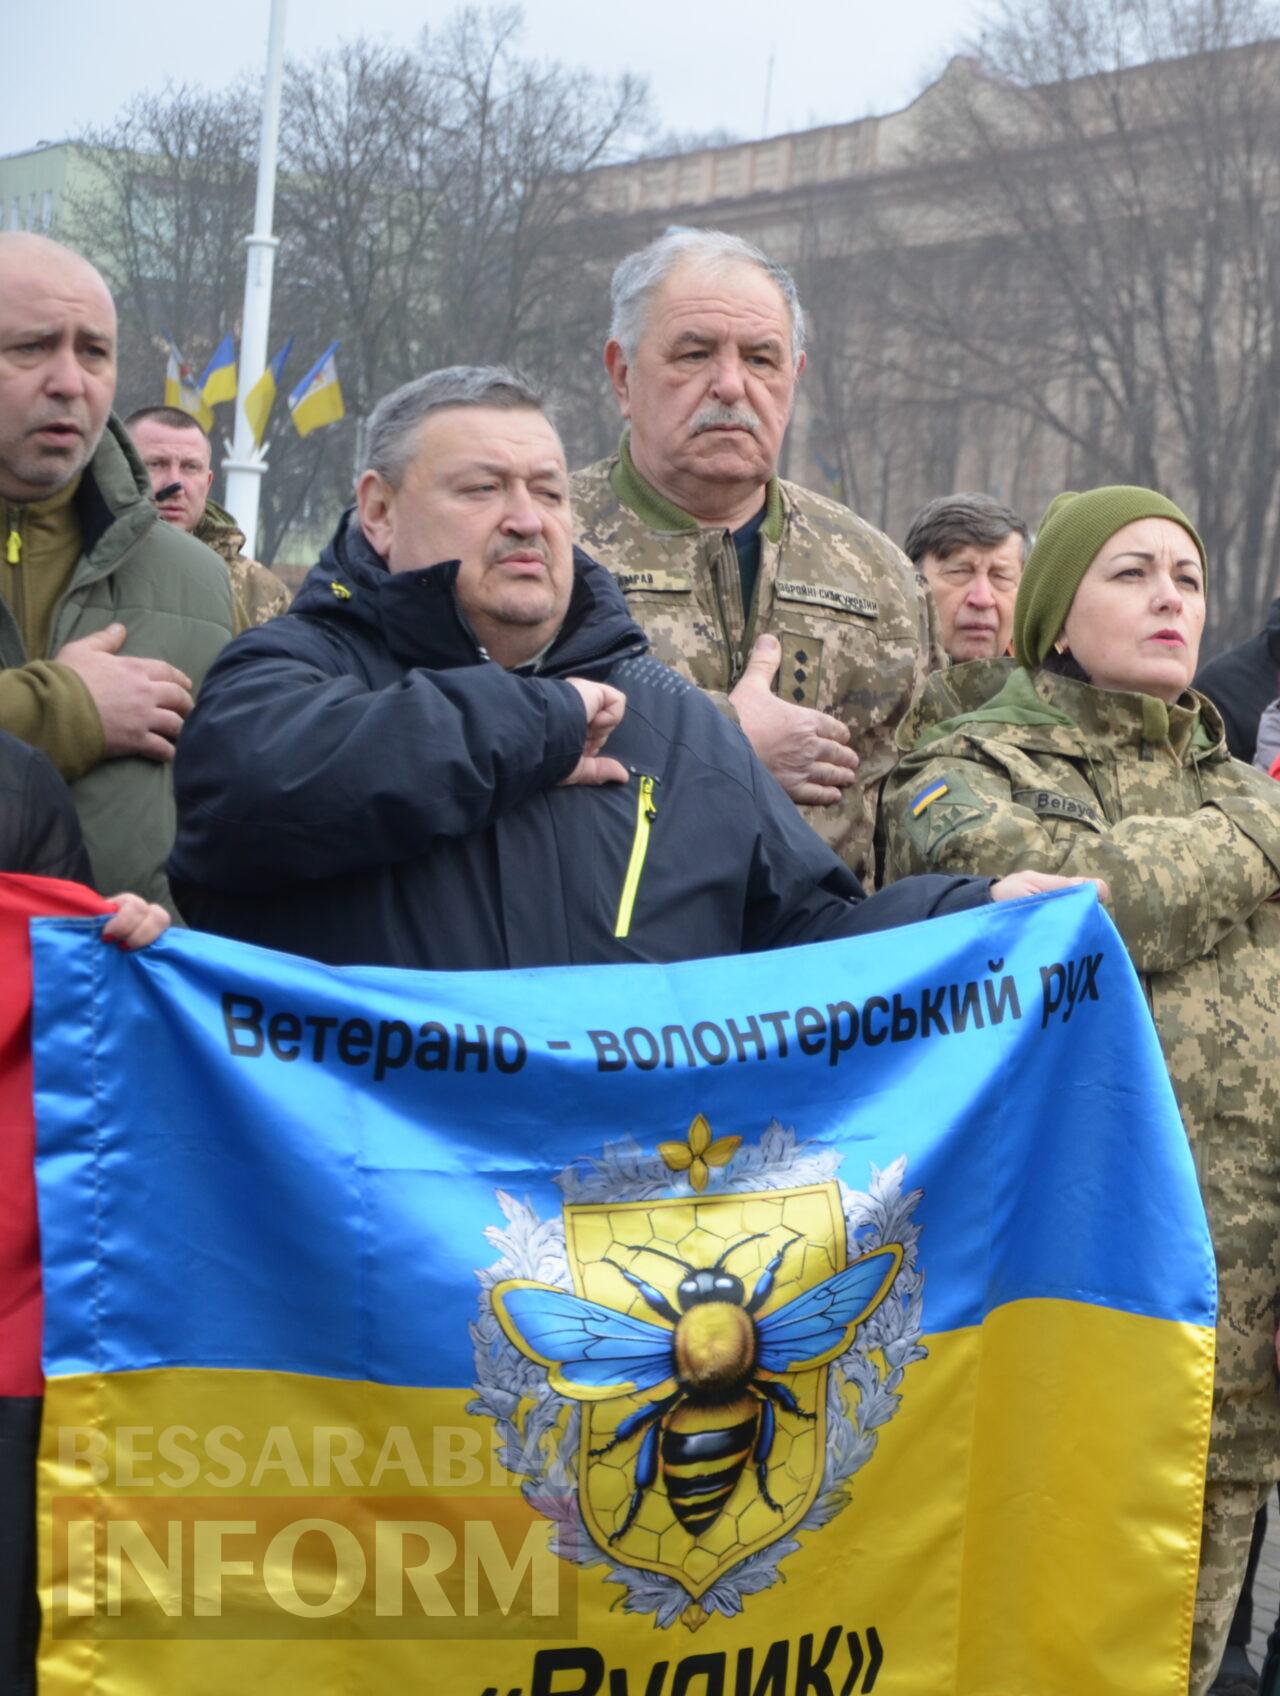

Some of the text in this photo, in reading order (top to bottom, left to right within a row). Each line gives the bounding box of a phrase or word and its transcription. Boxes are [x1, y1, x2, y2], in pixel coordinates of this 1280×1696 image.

[779, 583, 817, 598] ЗБРОЙНІ
[220, 993, 527, 1081] Ветерано
[587, 957, 1023, 1072] волонтерський
[1038, 952, 1105, 1030] рух
